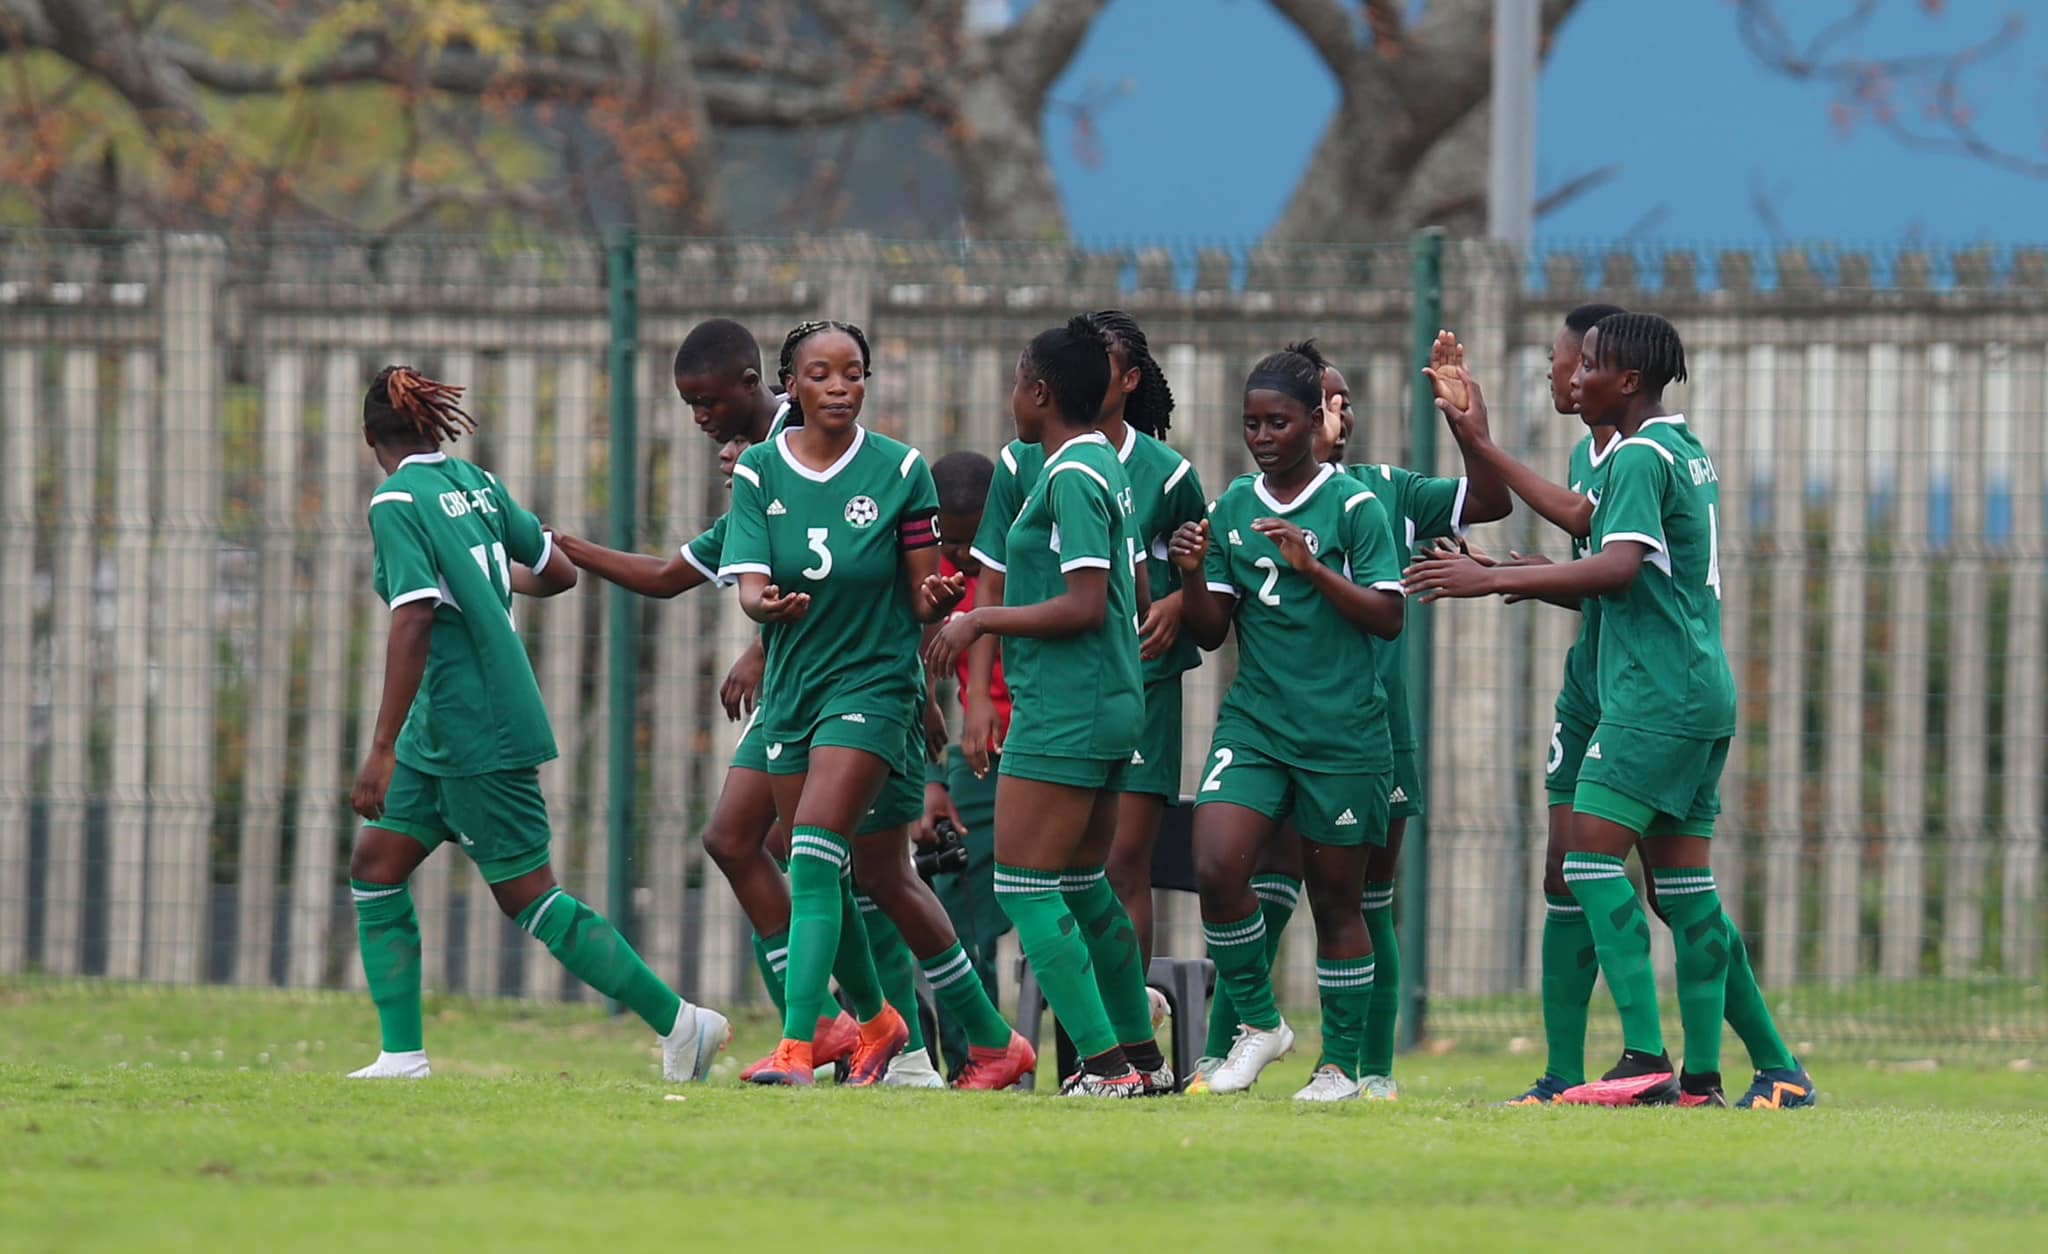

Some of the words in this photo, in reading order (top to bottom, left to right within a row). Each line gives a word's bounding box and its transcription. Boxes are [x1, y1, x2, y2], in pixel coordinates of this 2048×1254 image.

[802, 527, 832, 580] 3
[1254, 556, 1281, 606] 2
[1201, 747, 1233, 792] 2
[1546, 722, 1563, 774] 5
